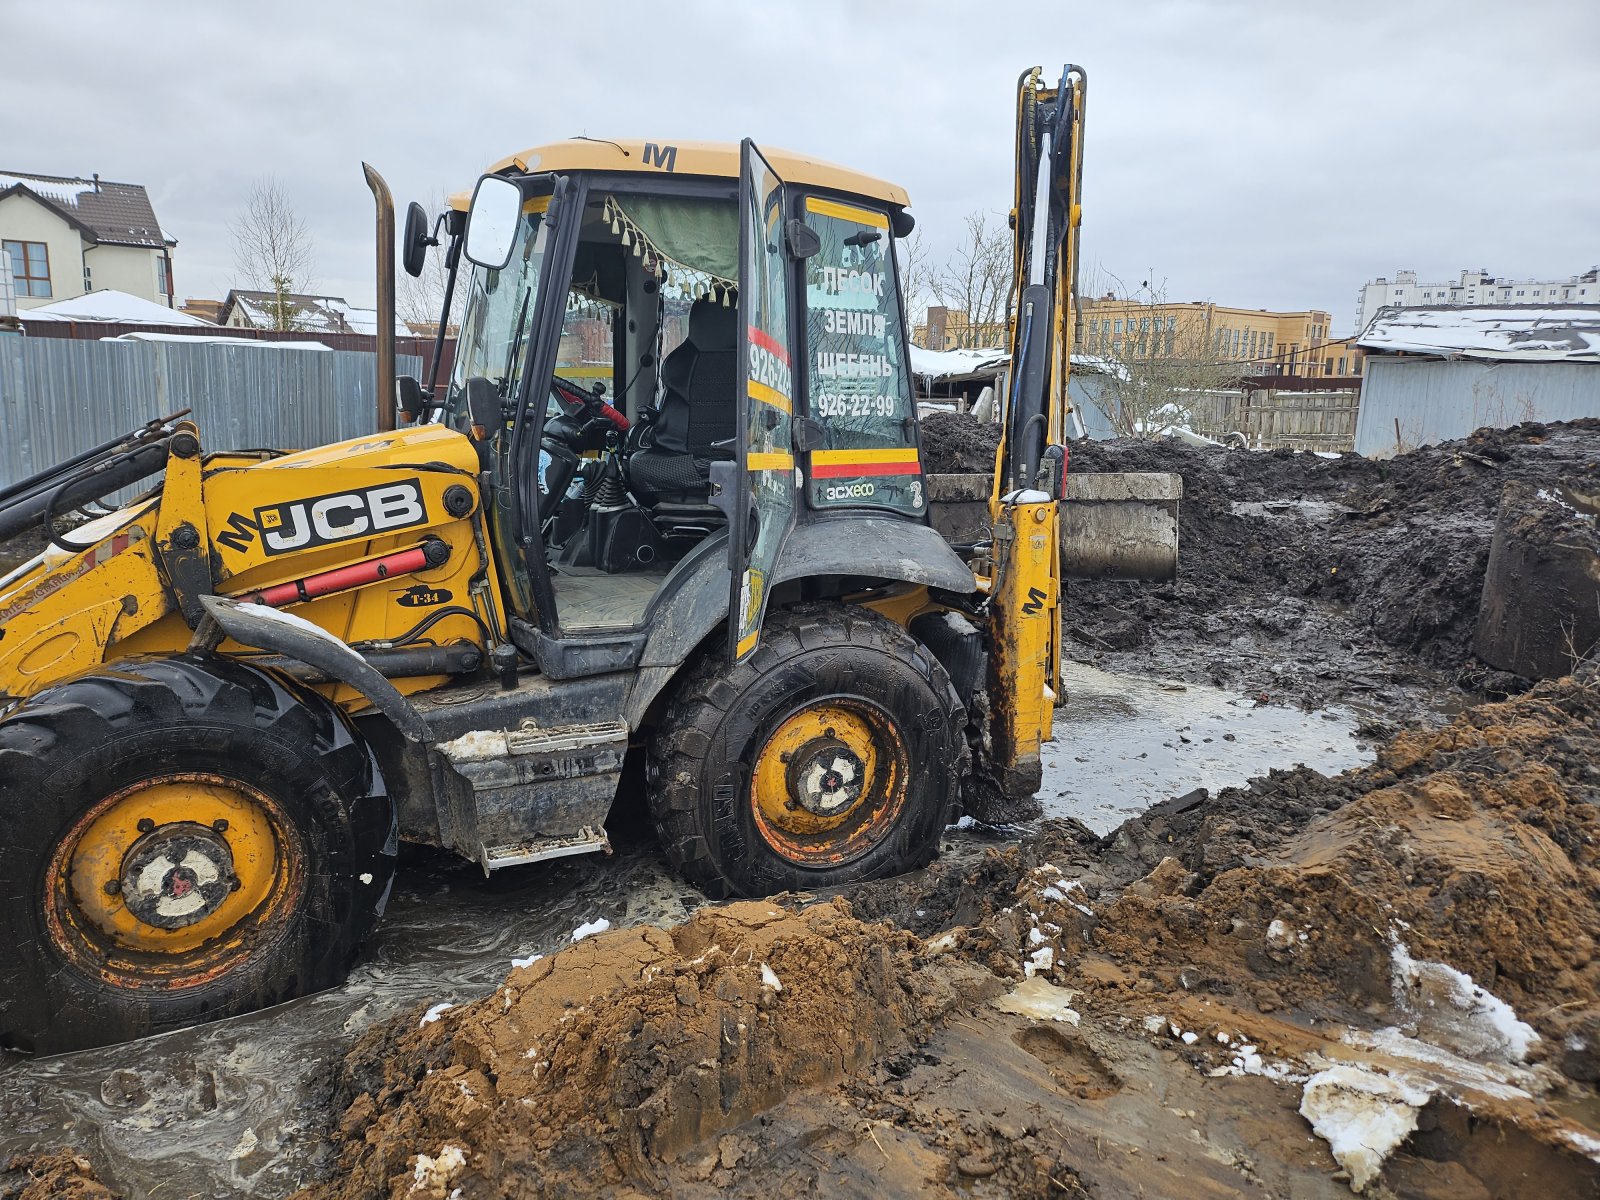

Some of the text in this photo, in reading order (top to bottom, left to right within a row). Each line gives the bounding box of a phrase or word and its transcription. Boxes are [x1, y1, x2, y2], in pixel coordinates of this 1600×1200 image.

[824, 266, 886, 297] ПЕСОК
[825, 310, 886, 338] ЗЕМЛЯ
[817, 352, 893, 379] ЩЕБЕНЬ
[818, 394, 894, 417] 926-22-99
[265, 484, 424, 551] JCB
[410, 592, 440, 605] T-34
